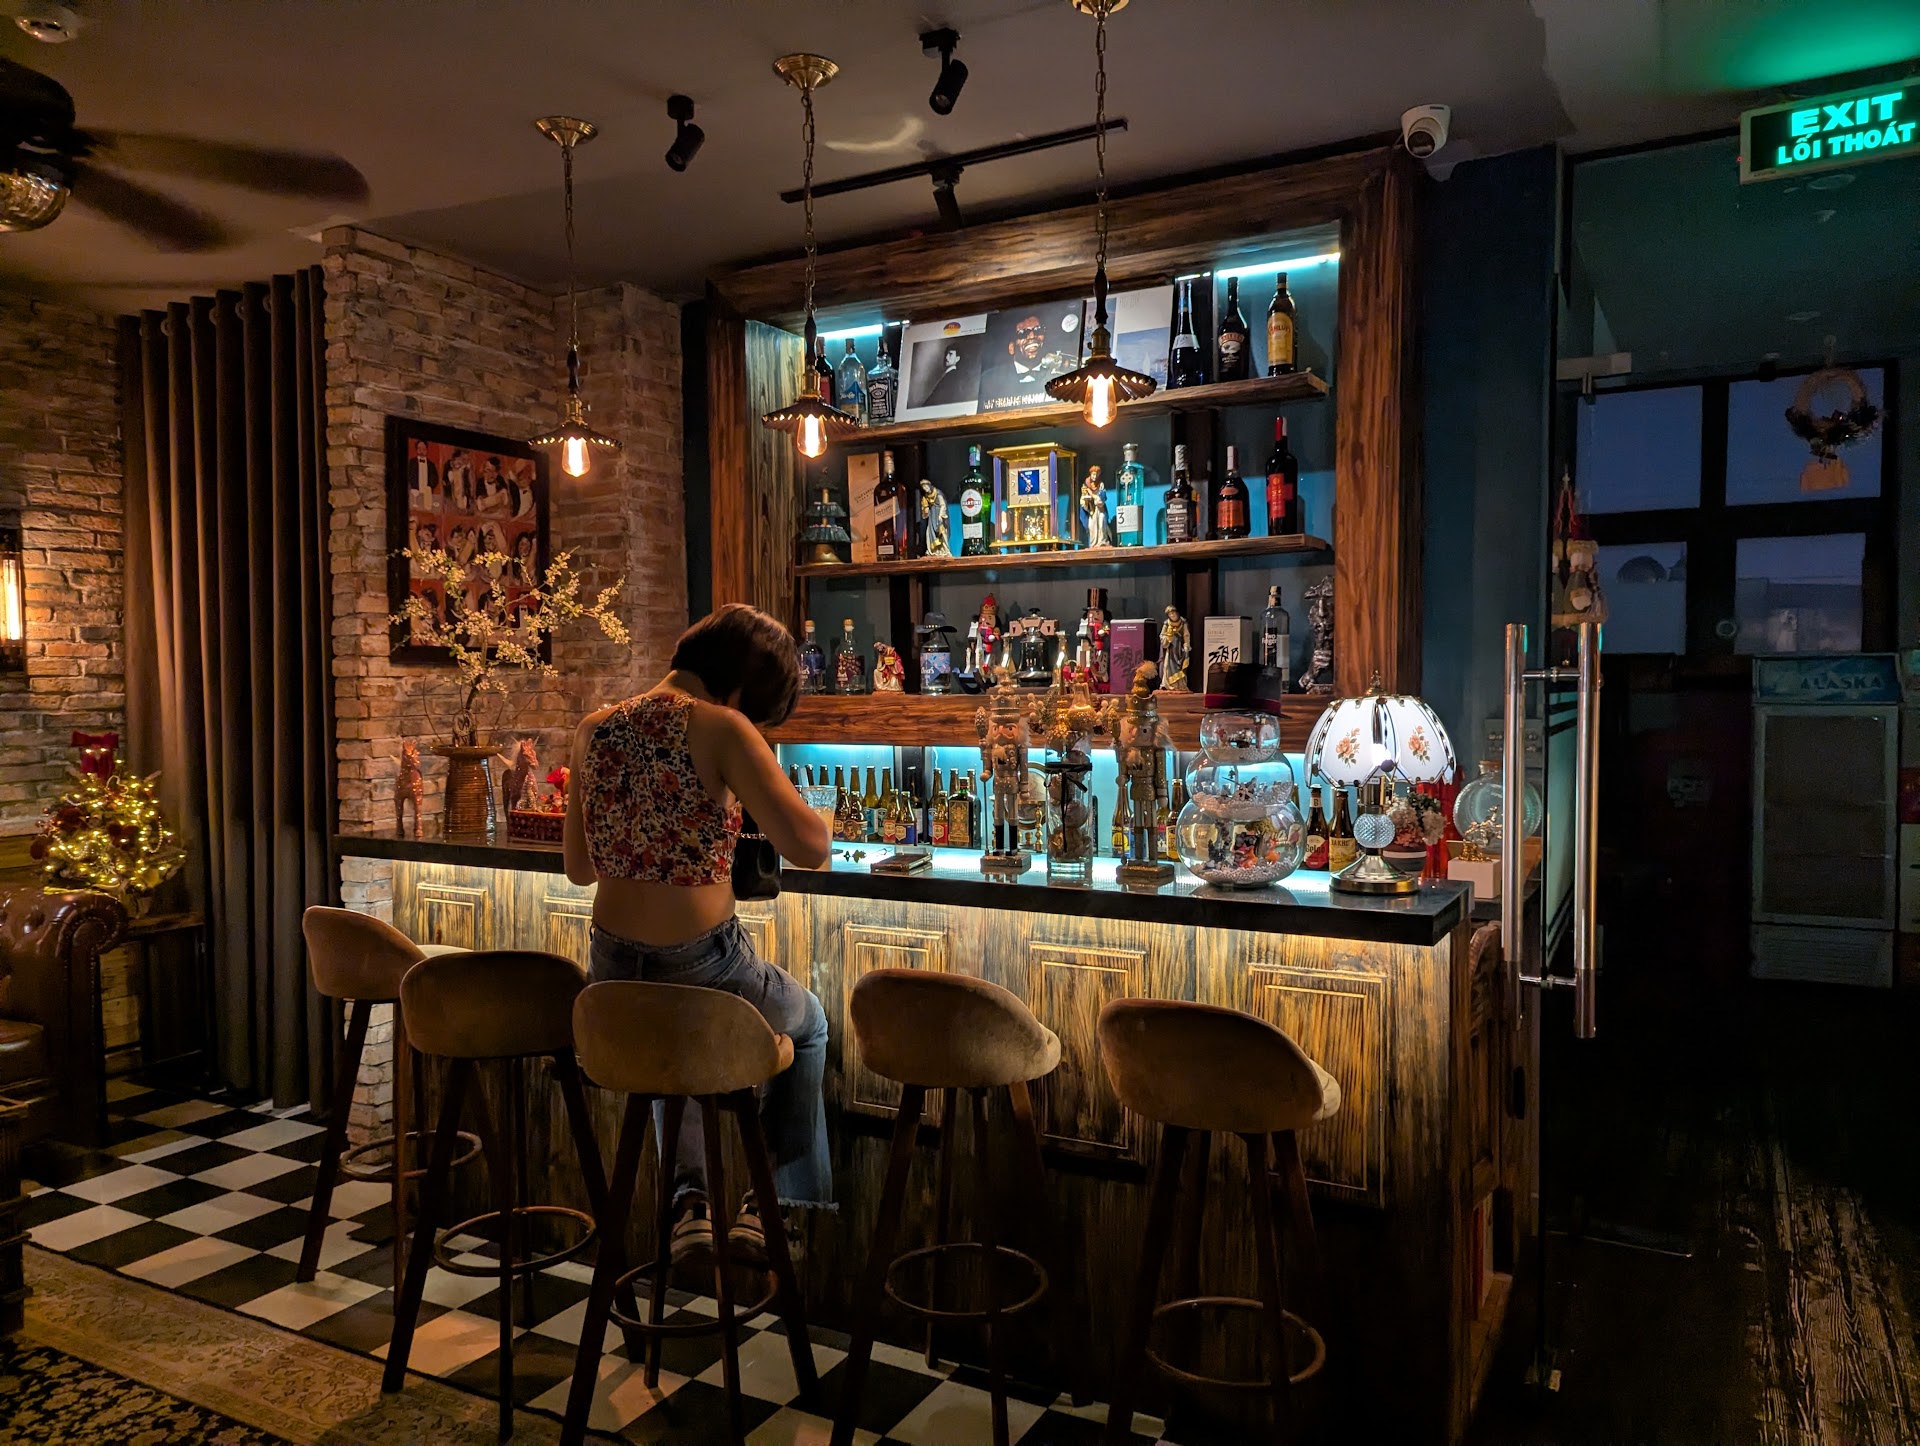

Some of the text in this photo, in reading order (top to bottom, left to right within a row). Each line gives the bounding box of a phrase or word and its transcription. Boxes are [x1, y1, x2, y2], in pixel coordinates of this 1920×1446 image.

[1791, 92, 1903, 137] EXIT
[1777, 120, 1916, 165] LỐI THOÁT
[1118, 512, 1125, 525] 3
[1800, 675, 1882, 690] ALASKA
